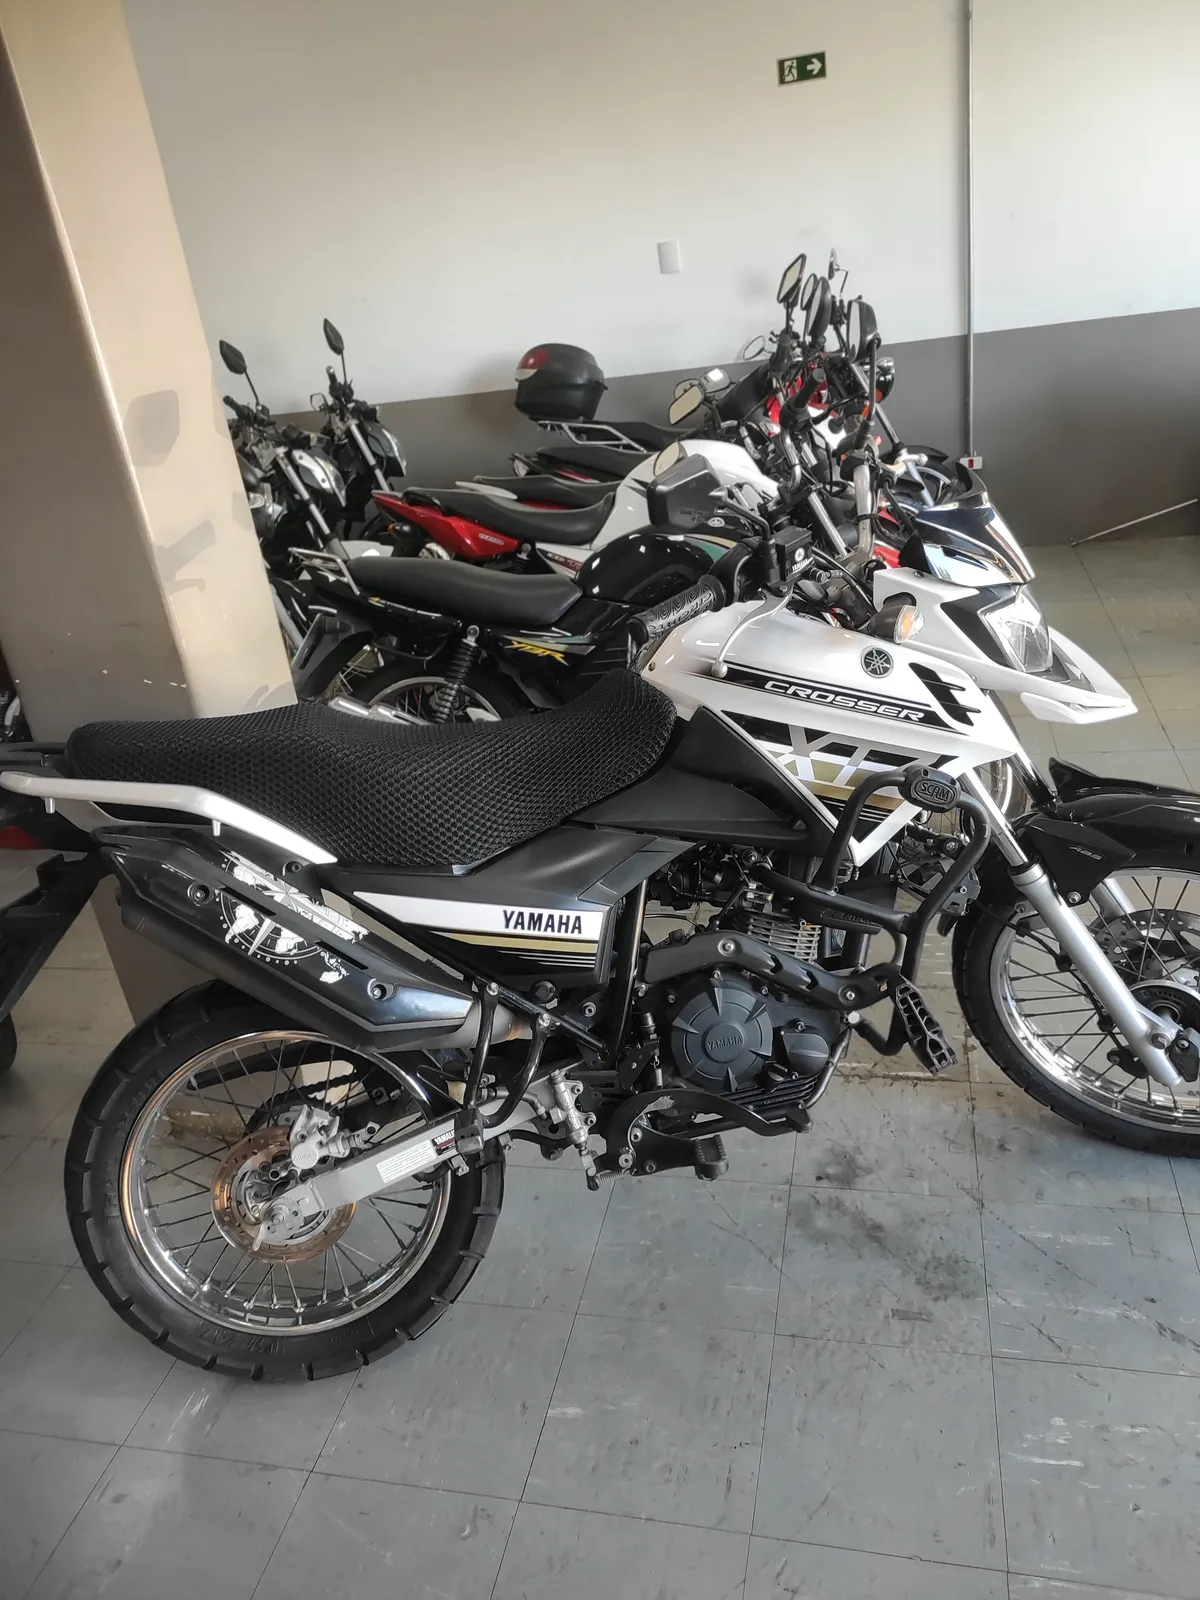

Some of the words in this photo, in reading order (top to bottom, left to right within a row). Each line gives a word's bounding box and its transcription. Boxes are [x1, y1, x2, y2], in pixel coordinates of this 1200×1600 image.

[764, 680, 925, 722] CROSSER
[918, 782, 950, 803] SCAM
[502, 909, 582, 934] YAMAHA
[706, 1035, 743, 1051] YAMAHA
